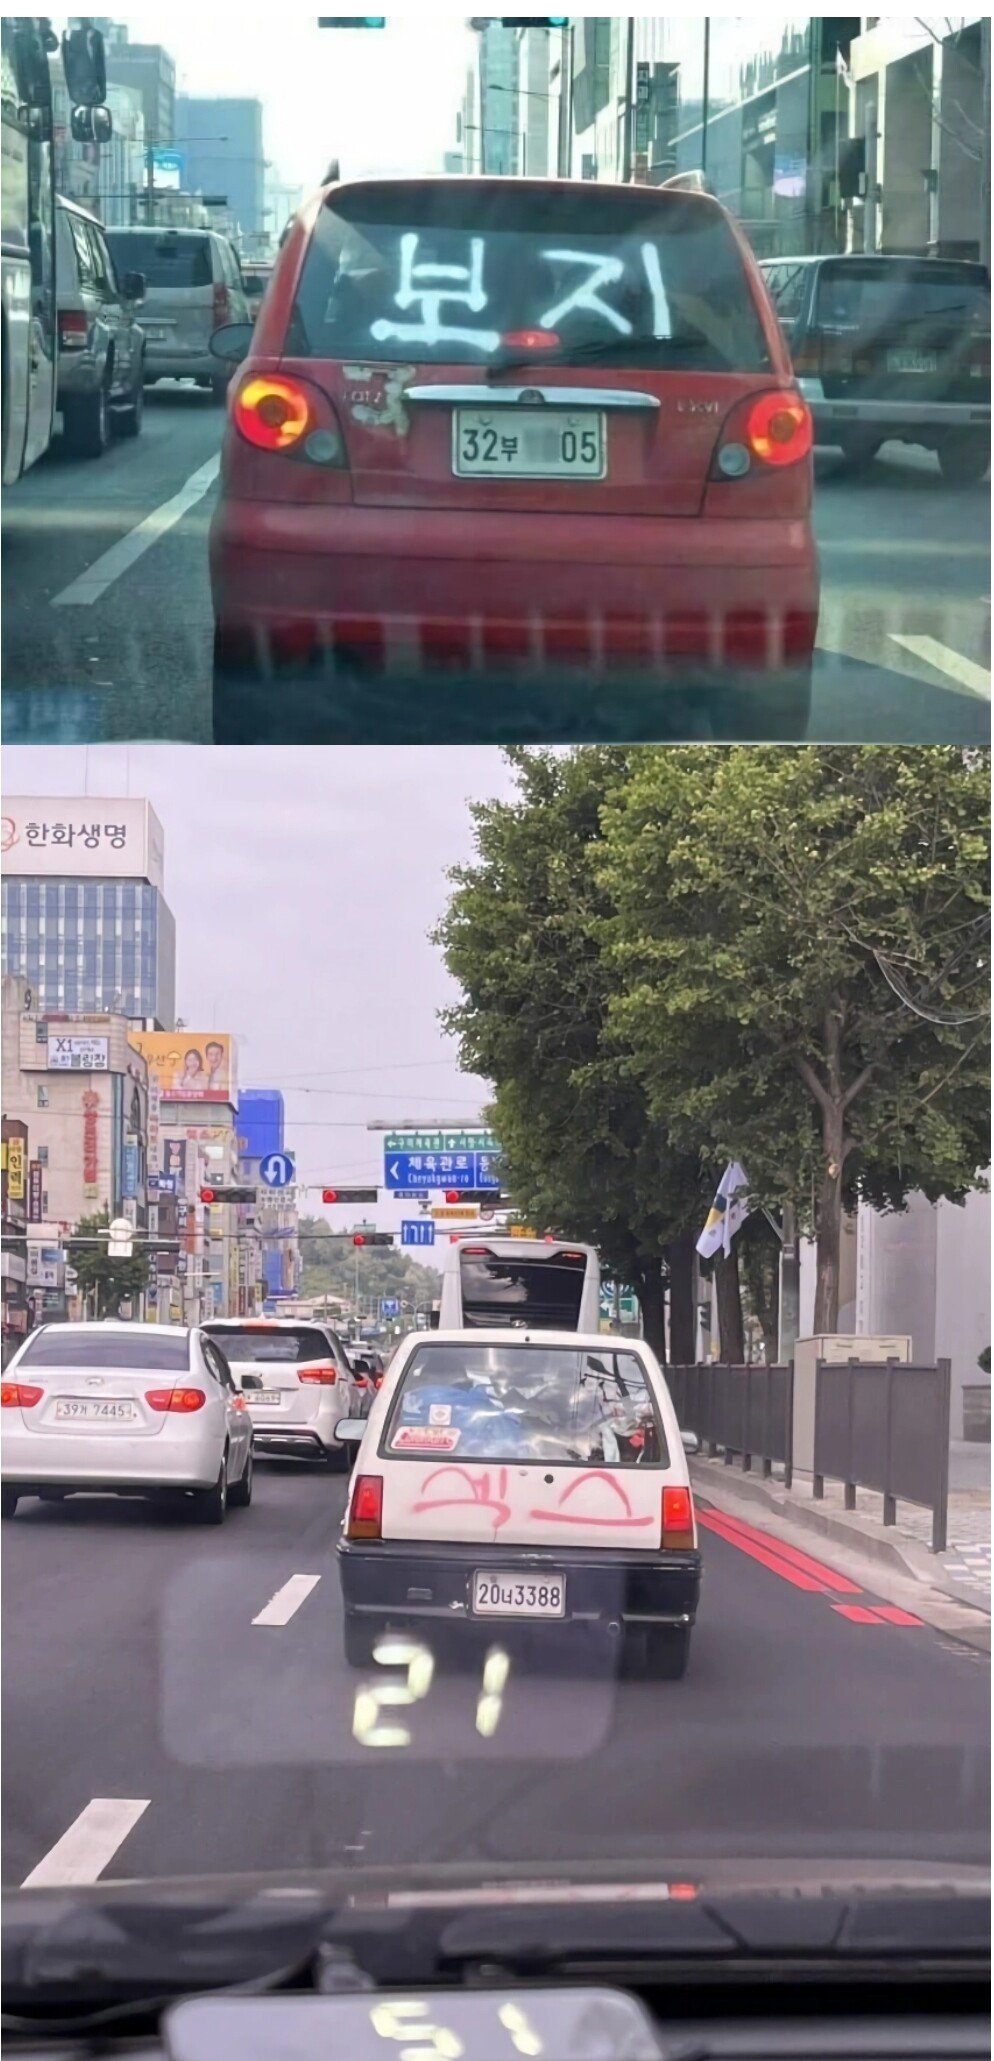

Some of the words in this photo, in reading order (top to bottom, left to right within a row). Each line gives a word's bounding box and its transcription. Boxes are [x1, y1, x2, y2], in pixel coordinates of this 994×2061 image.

[371, 232, 674, 351] 보지
[25, 822, 127, 849] 한화생명
[408, 1156, 468, 1172] 체육관로
[478, 1583, 561, 1607] 20너3388
